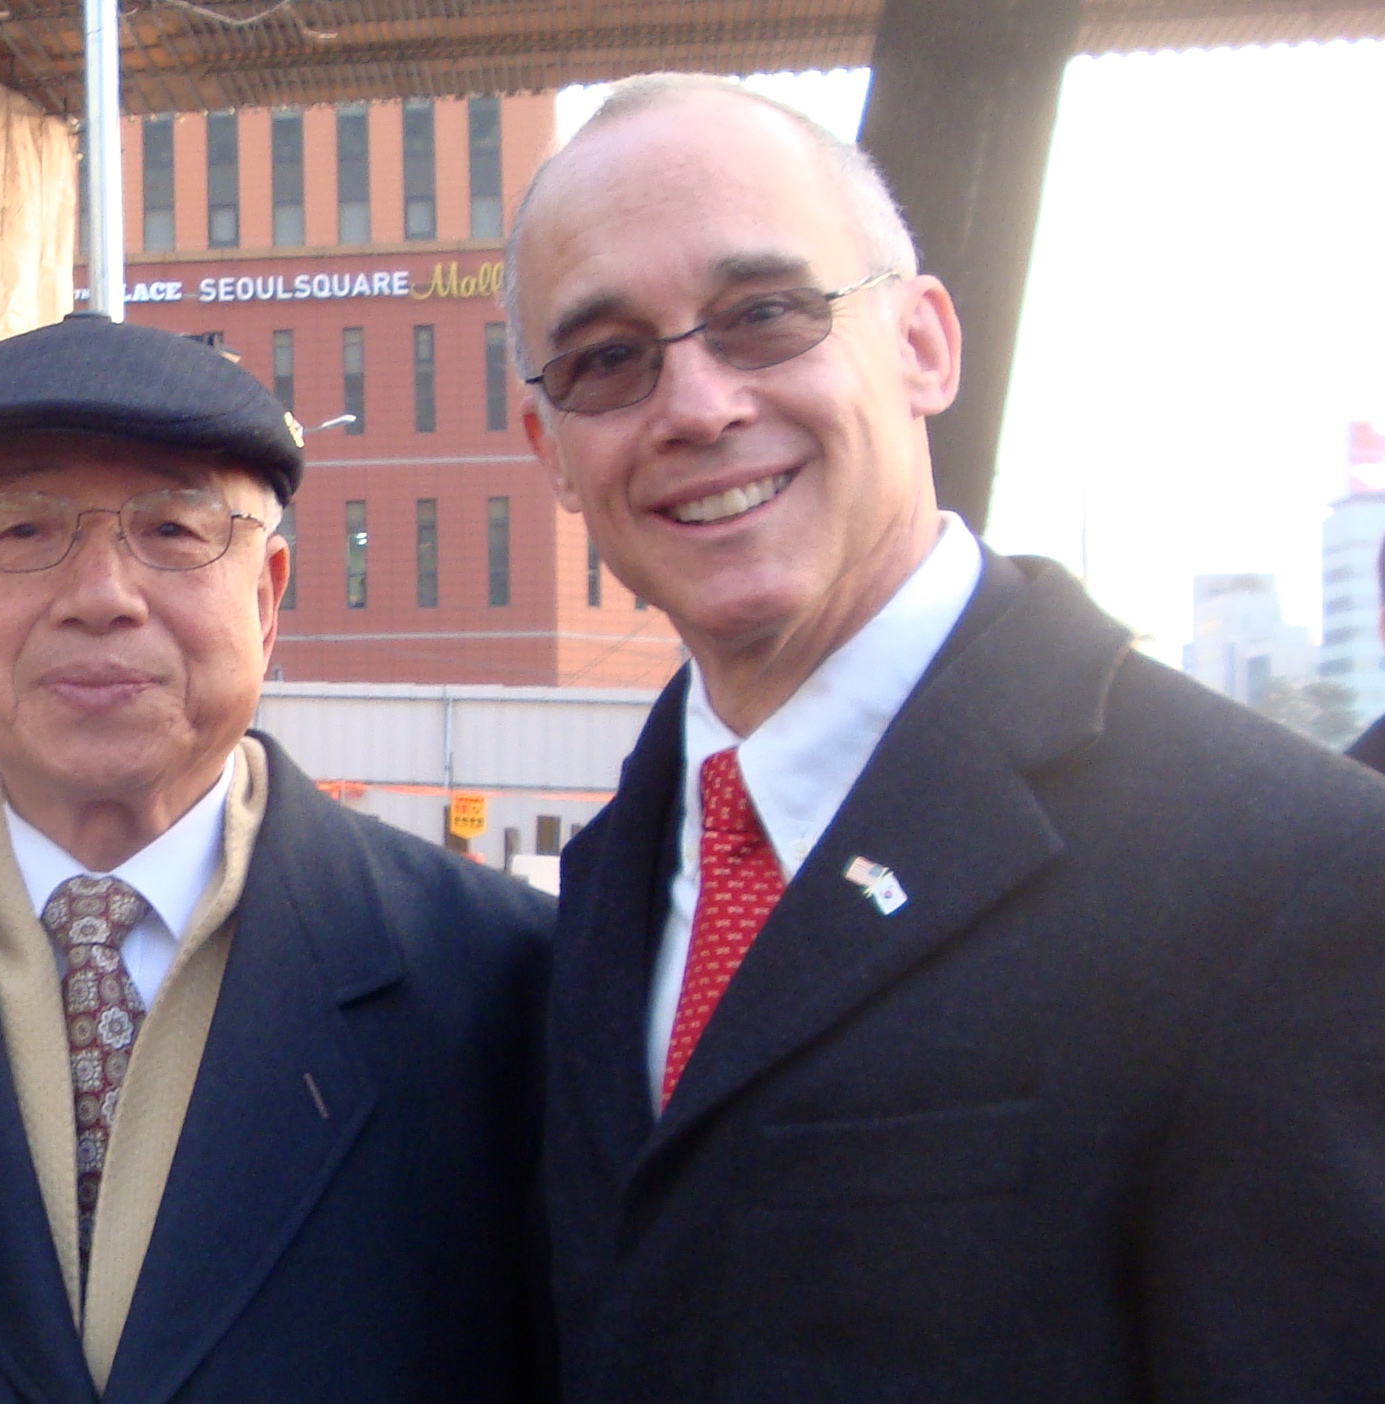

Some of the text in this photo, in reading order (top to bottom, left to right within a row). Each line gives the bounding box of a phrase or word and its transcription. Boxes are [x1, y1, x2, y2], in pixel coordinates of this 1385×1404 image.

[122, 281, 183, 302] LACE
[199, 270, 410, 303] SEOULSQUARE
[410, 260, 505, 301] Mall
